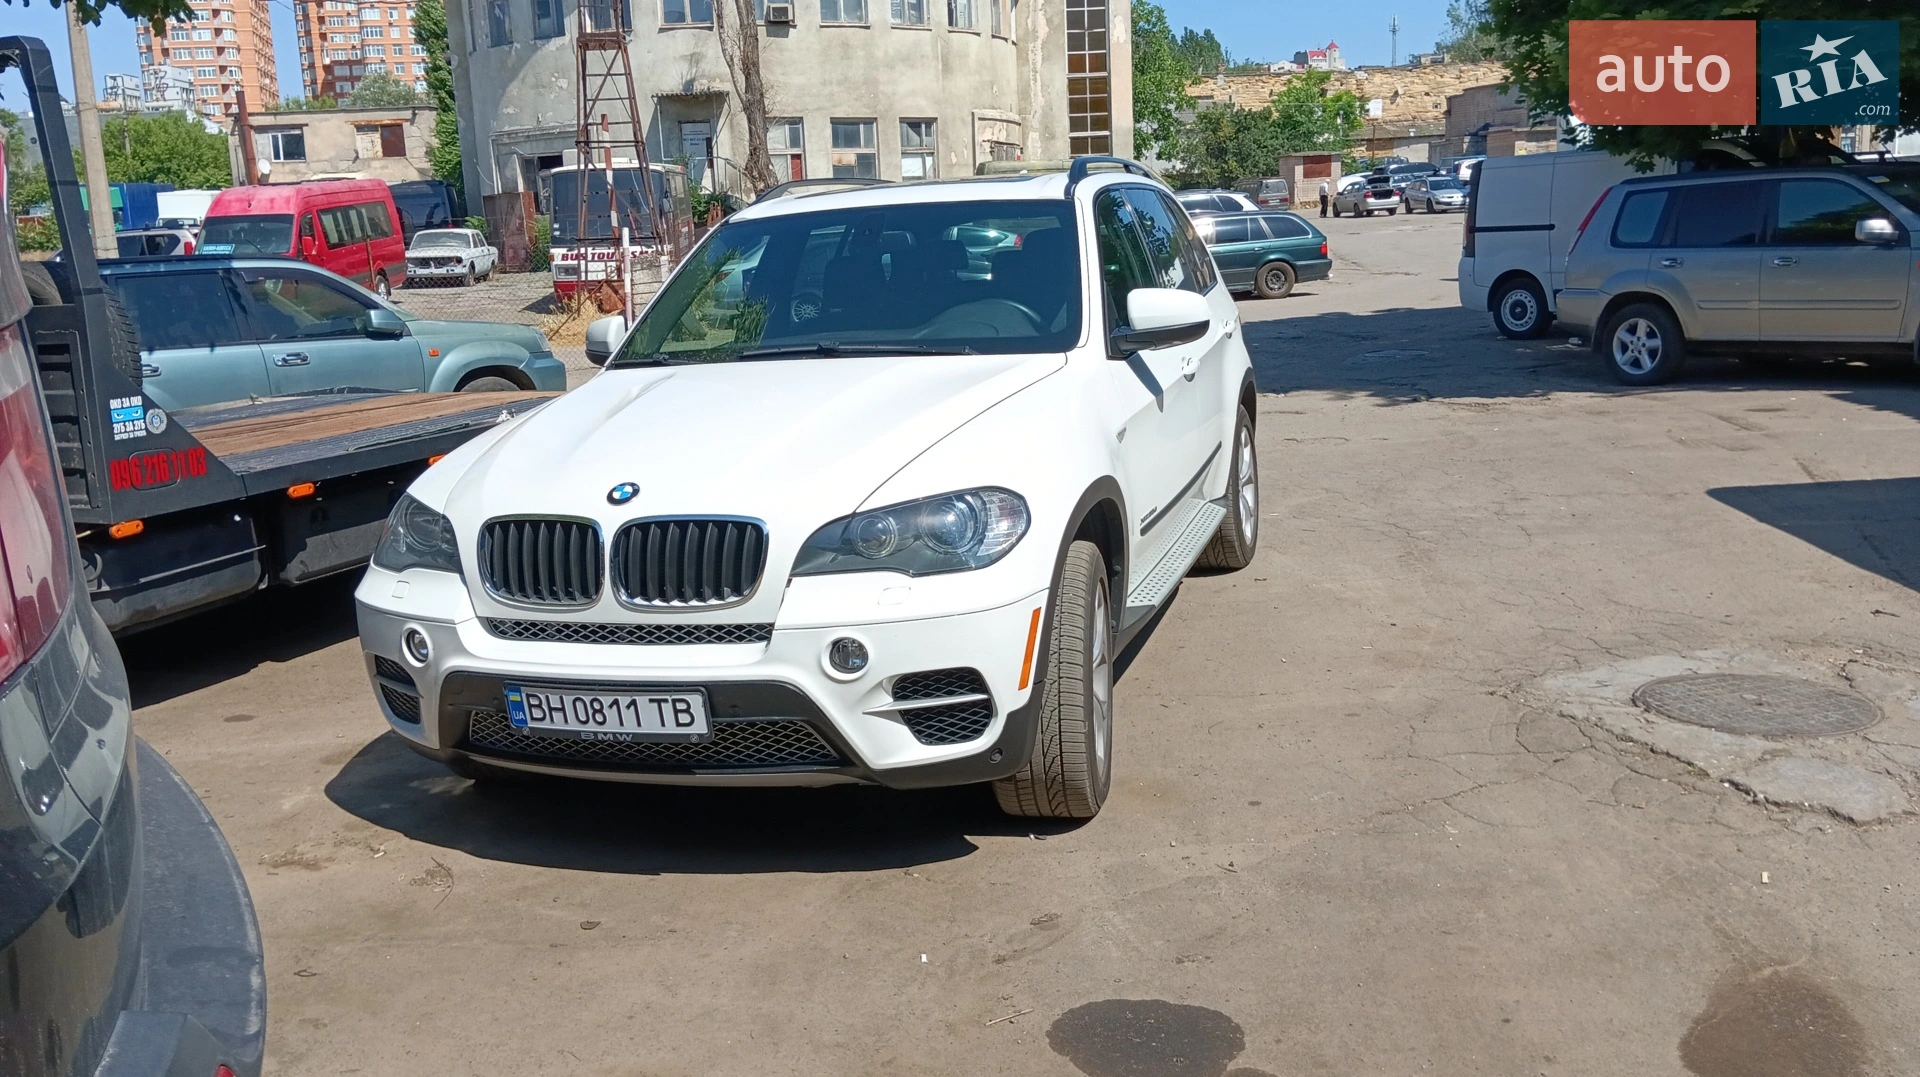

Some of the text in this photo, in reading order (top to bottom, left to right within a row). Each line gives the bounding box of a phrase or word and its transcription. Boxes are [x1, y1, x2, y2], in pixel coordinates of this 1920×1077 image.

[561, 253, 587, 261] BUS
[110, 395, 142, 409] ОКО ЗА ОКО
[113, 419, 145, 434] ЗУБ ЗА ЗУБ
[109, 445, 207, 491] 096 216 11 03
[512, 710, 526, 721] UA
[525, 692, 696, 728] BH 0811 TB
[580, 732, 633, 742] BMW
